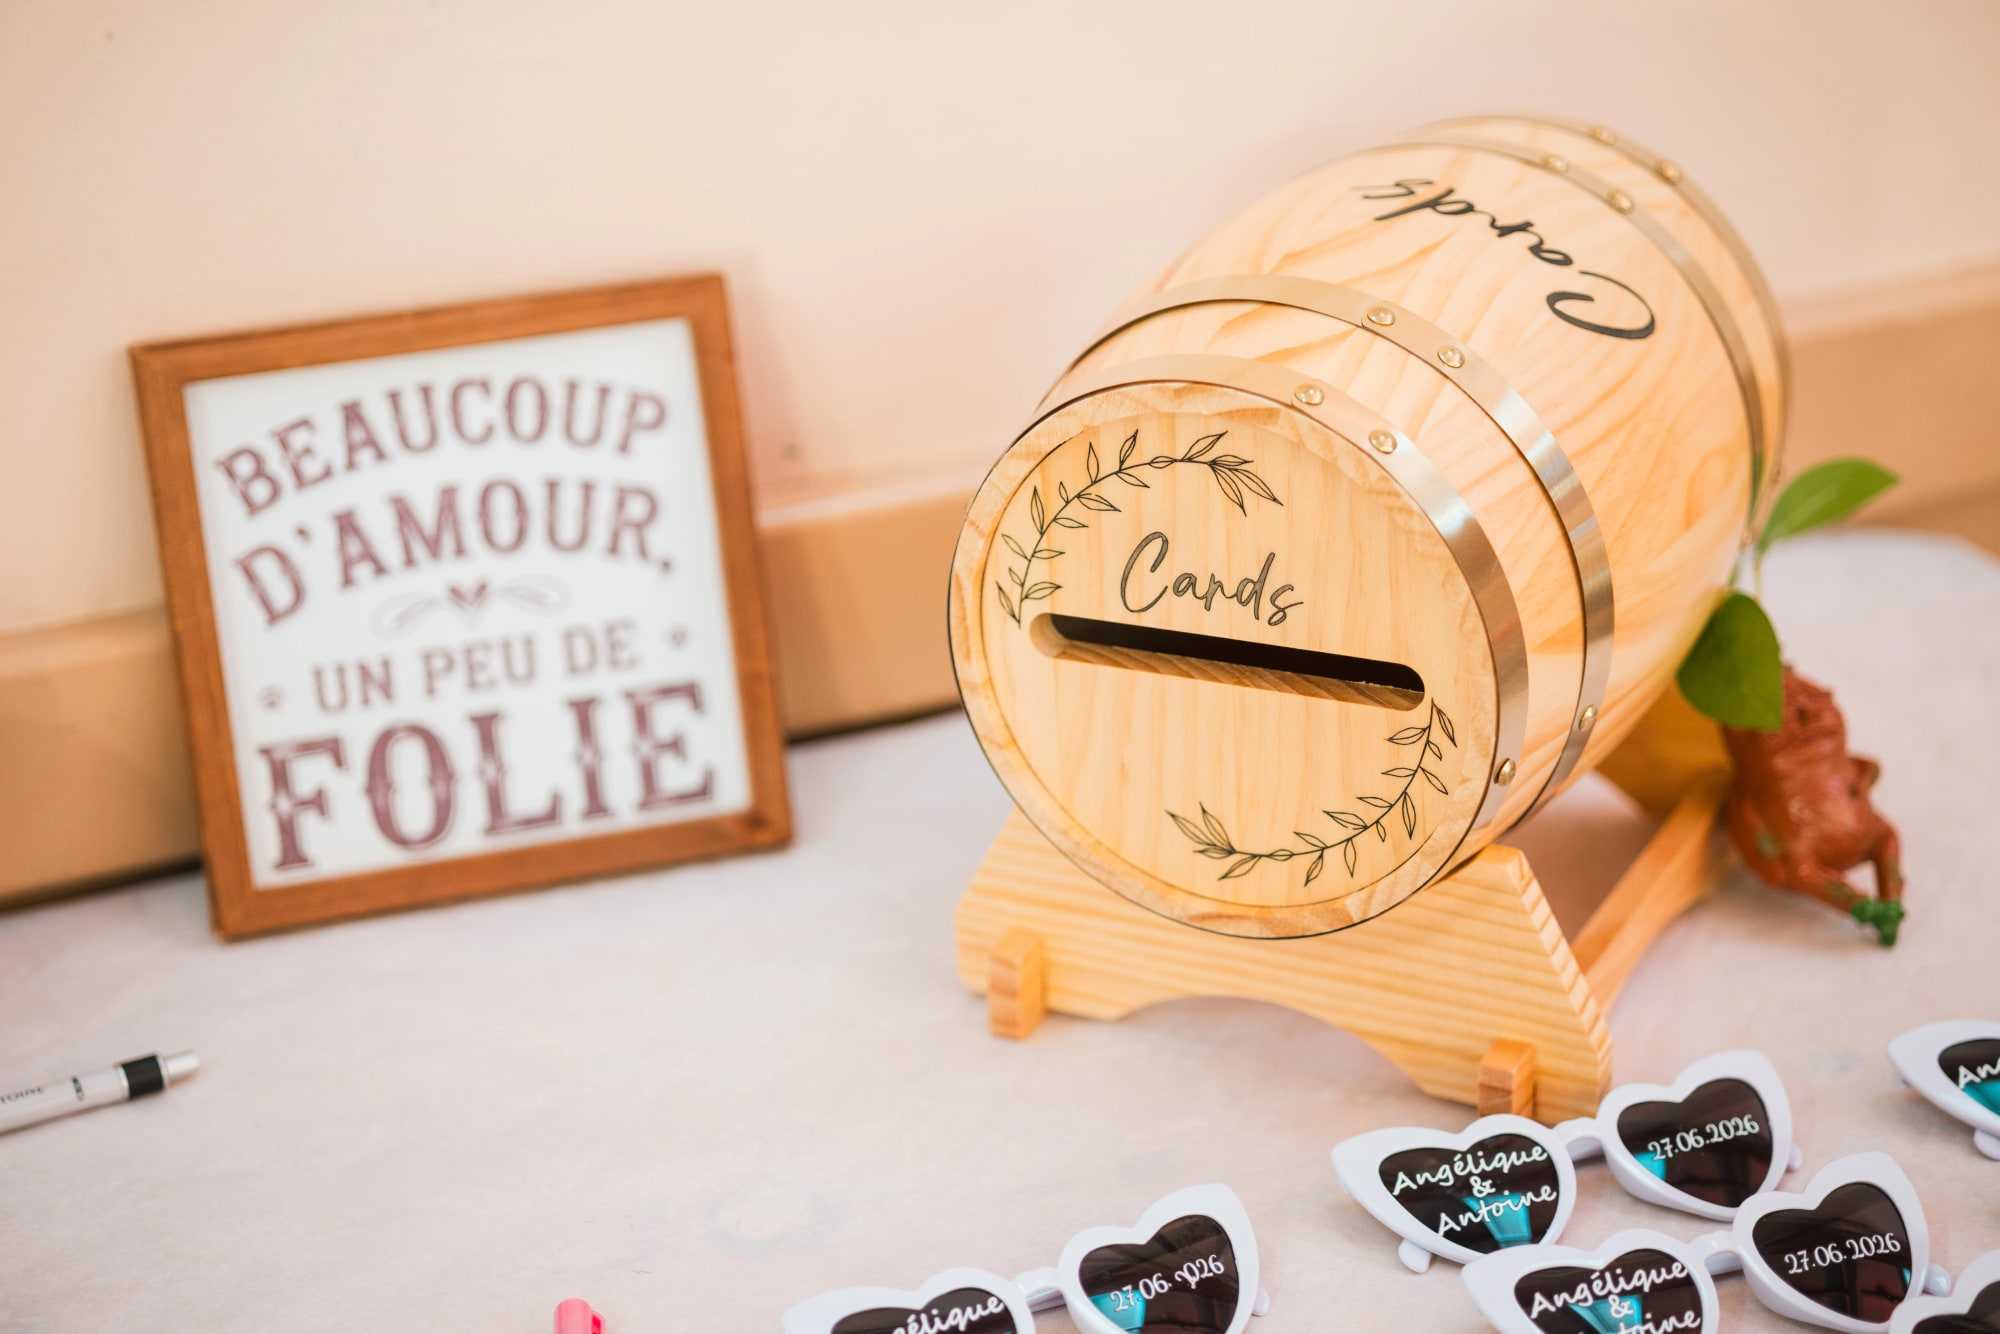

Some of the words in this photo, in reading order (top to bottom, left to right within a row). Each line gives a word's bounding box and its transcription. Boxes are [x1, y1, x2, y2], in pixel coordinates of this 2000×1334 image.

[1350, 178, 1656, 340] Cards
[215, 375, 669, 518] BEAUCOUP
[233, 478, 674, 627] D'AMOUR,
[1120, 531, 1304, 626] Cards
[312, 656, 394, 712] UN
[422, 634, 536, 697] PEU
[563, 620, 638, 675] DE
[257, 681, 716, 871] FOLIE
[1647, 1113, 1760, 1161] 27.06.2026
[1391, 1145, 1549, 1196] Angélique
[1469, 1175, 1496, 1197] &
[1437, 1185, 1557, 1238] Antoine
[1784, 1232, 1901, 1274] 27.06.2026
[1530, 1261, 1689, 1319] Angélique
[1608, 1294, 1634, 1318] &
